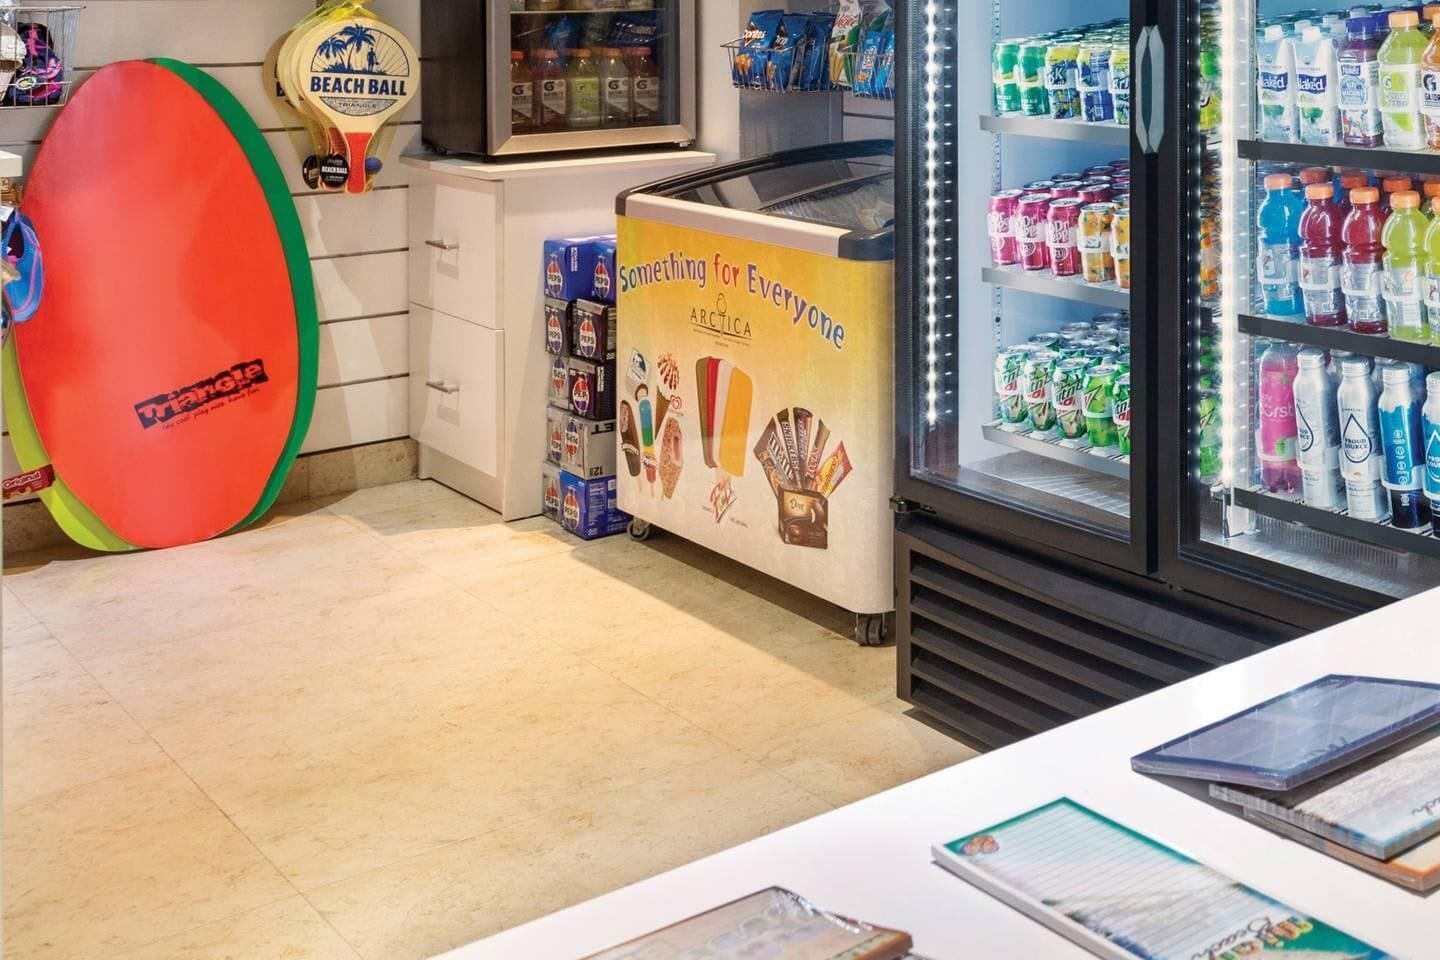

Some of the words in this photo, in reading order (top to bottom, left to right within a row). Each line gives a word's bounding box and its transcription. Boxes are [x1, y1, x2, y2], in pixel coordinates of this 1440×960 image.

[310, 75, 364, 93] BEACH
[368, 78, 407, 96] BALL
[619, 252, 707, 293] Something
[713, 253, 741, 288] for
[747, 263, 845, 350] Everyone
[690, 307, 752, 337] ARCTICA
[1344, 438, 1367, 446] PROUD
